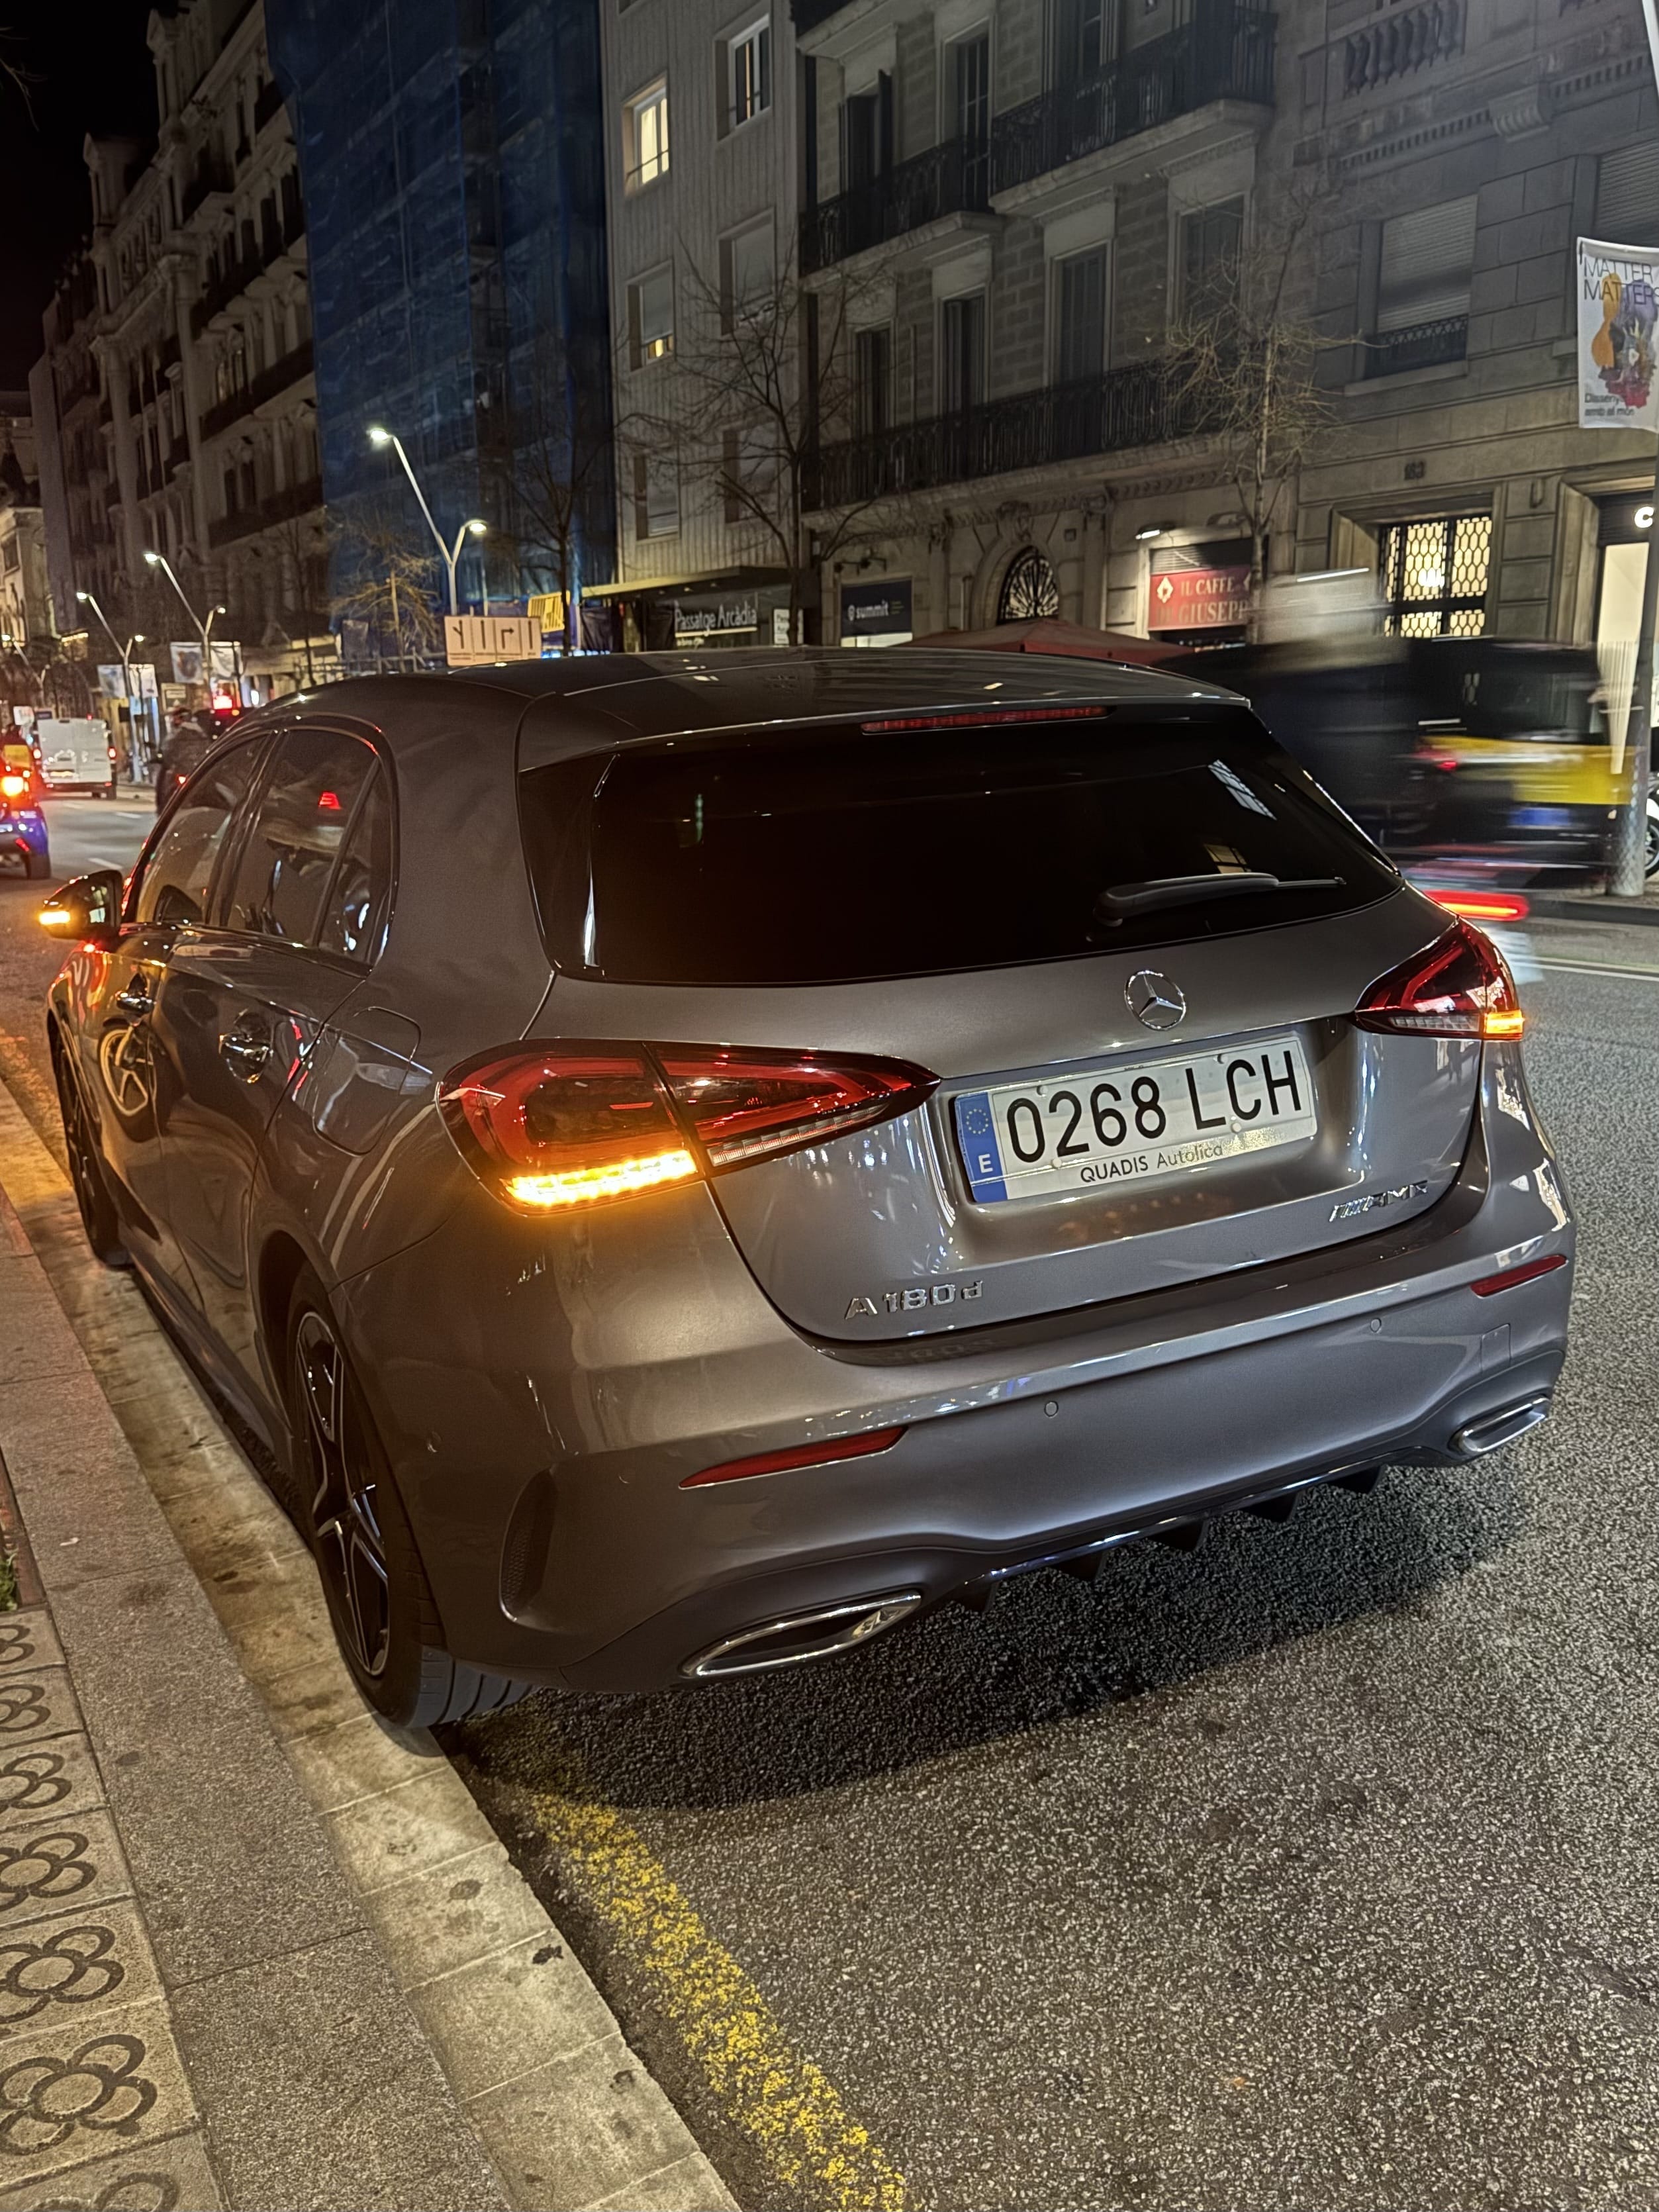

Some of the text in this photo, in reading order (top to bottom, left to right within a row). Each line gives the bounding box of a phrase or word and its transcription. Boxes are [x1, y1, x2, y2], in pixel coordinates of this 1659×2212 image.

[1584, 256, 1653, 283] MATTER
[1181, 580, 1192, 596] IL
[675, 601, 716, 636] Passatge
[856, 599, 889, 619] summit
[1178, 598, 1251, 624] GIUSEPP
[1006, 1050, 1302, 1164] 0268 LCH
[978, 1153, 993, 1173] E
[1080, 1155, 1149, 1183] QUADIS
